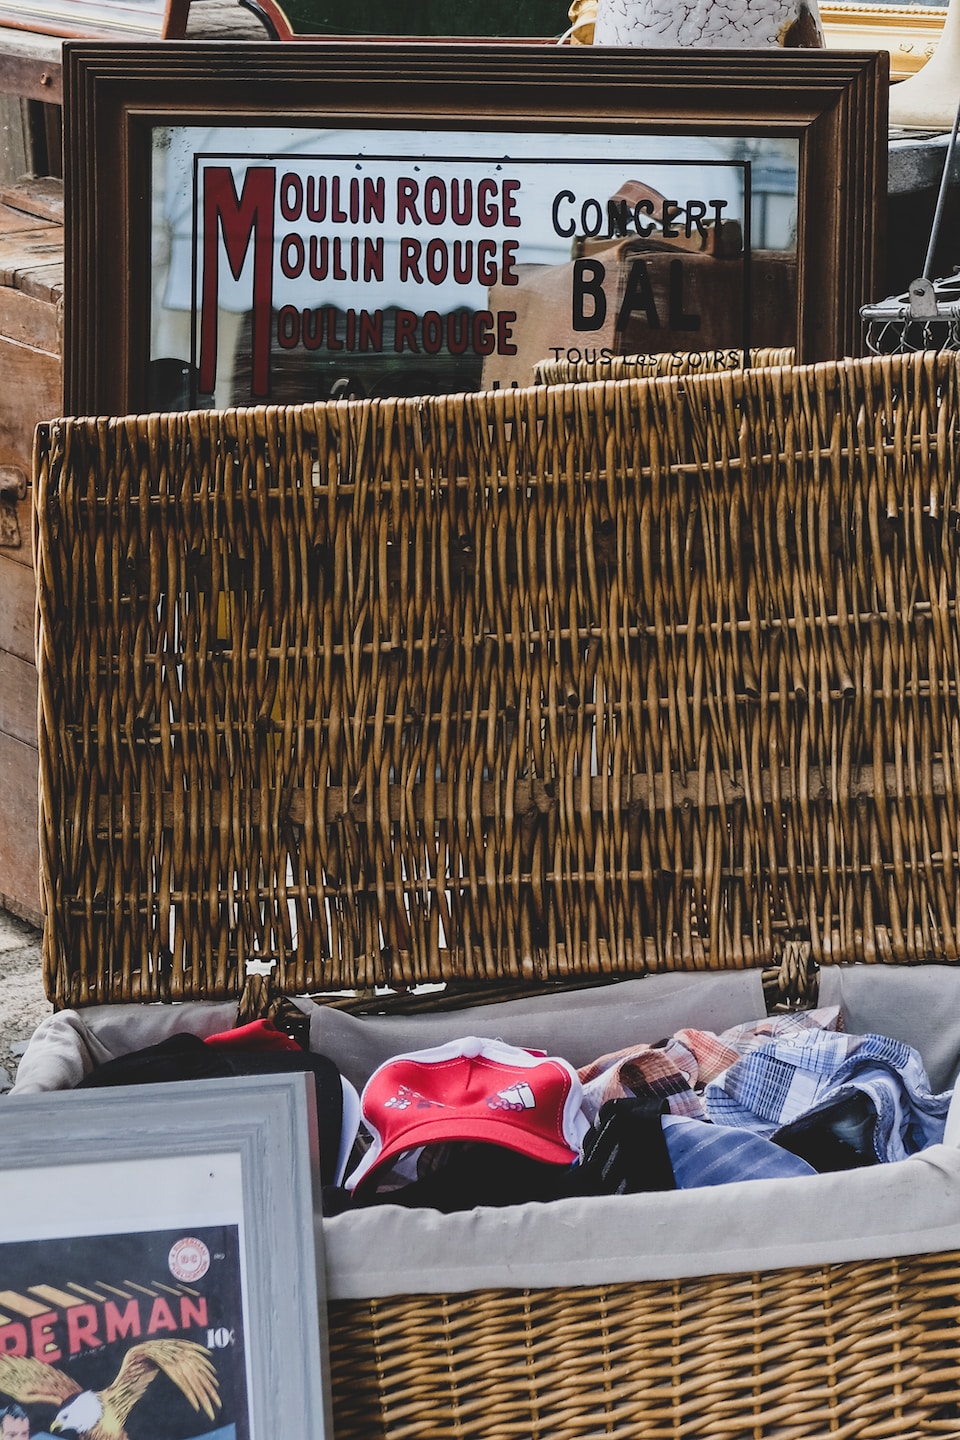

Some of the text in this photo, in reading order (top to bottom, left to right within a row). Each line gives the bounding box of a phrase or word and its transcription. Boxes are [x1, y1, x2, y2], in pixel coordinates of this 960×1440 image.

[397, 175, 521, 227] ROUGE
[400, 237, 519, 286] ROUGE
[572, 258, 702, 332] BAL
[394, 309, 518, 356] ROUGE
[548, 347, 616, 366] TOUS
